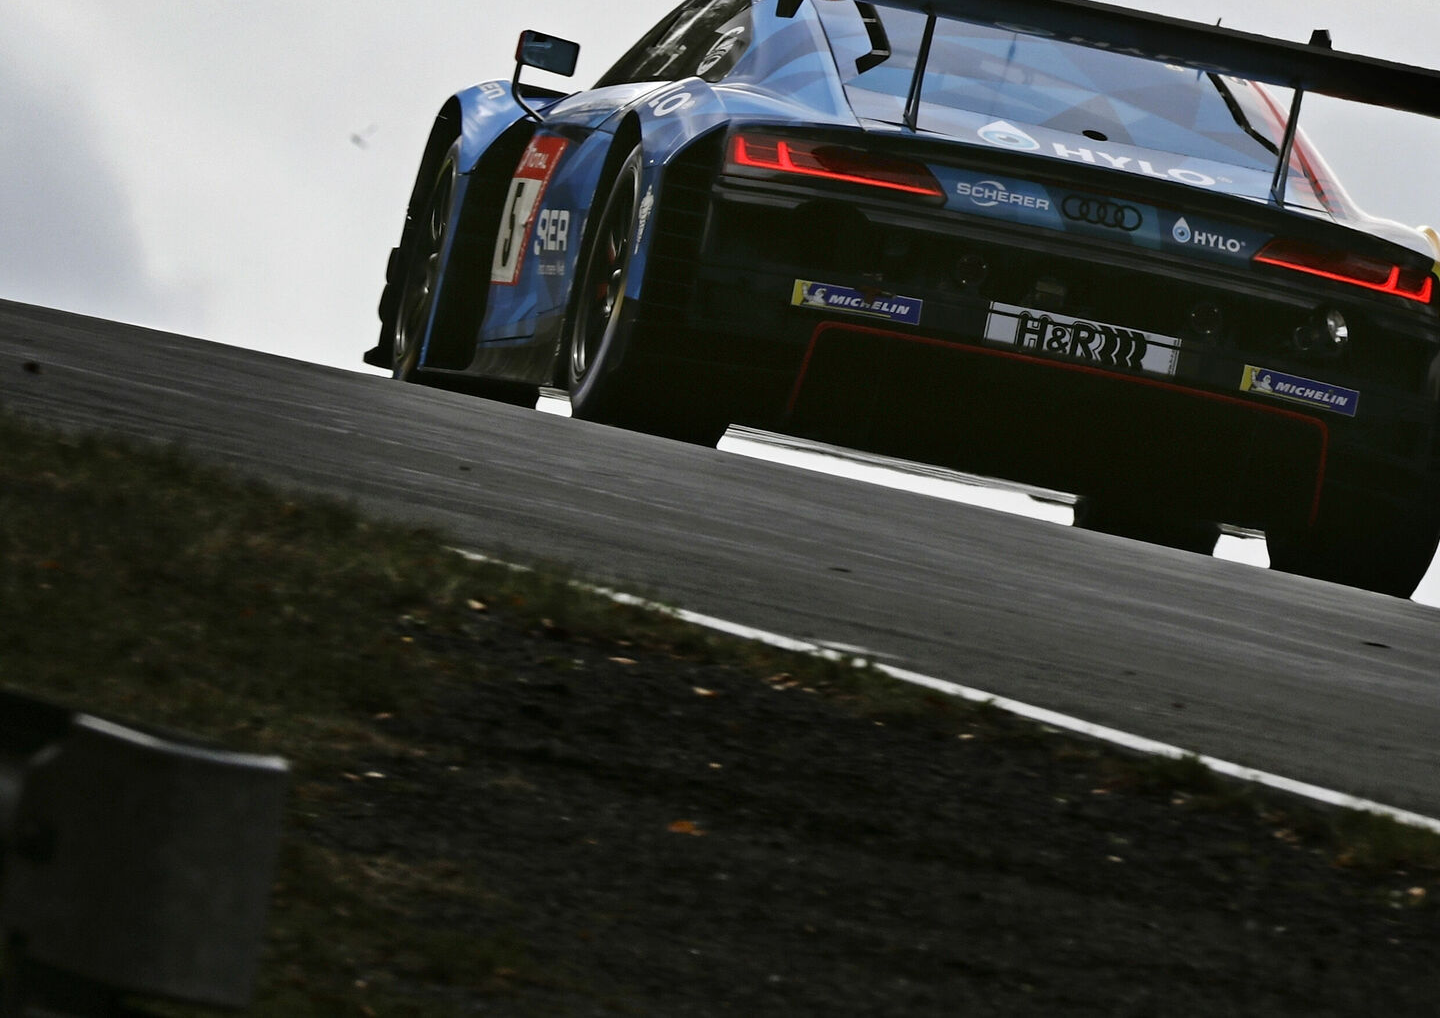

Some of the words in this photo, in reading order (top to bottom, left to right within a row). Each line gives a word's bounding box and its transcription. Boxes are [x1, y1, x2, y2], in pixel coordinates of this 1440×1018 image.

[956, 181, 1050, 211] SCHERER
[828, 294, 911, 315] MICHELIN
[1274, 382, 1349, 406] MICHELIN
